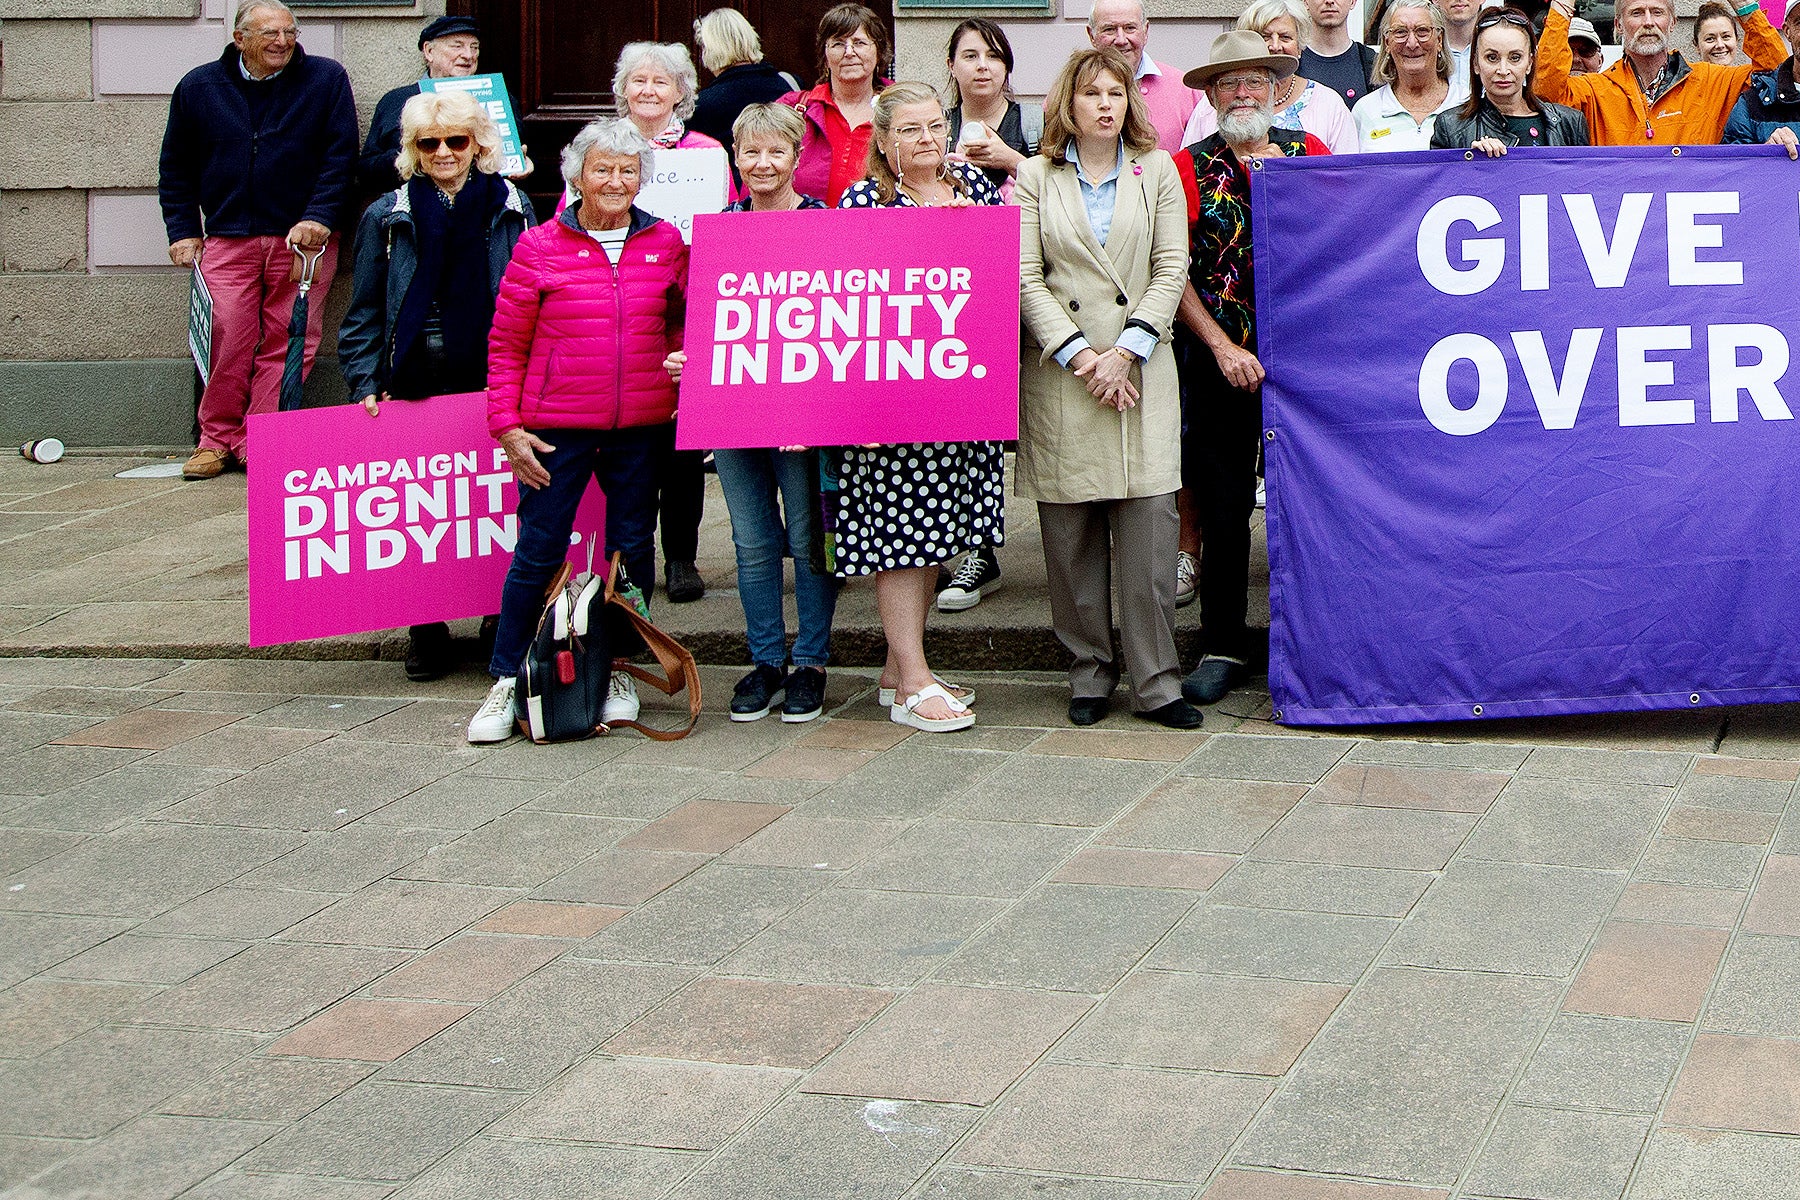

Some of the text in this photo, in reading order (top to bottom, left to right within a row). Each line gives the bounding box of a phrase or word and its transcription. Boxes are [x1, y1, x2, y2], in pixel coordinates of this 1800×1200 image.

[1416, 191, 1744, 296] GIVE
[717, 267, 972, 297] CAMPAIGN FOR
[192, 288, 210, 339] GIVE
[714, 293, 971, 341] DIGNITY
[710, 338, 987, 385] IN DYING.
[1418, 323, 1795, 437] OVER
[284, 451, 478, 494] CAMPAIGN
[284, 472, 515, 539] DIGNIT
[284, 532, 350, 582] IN
